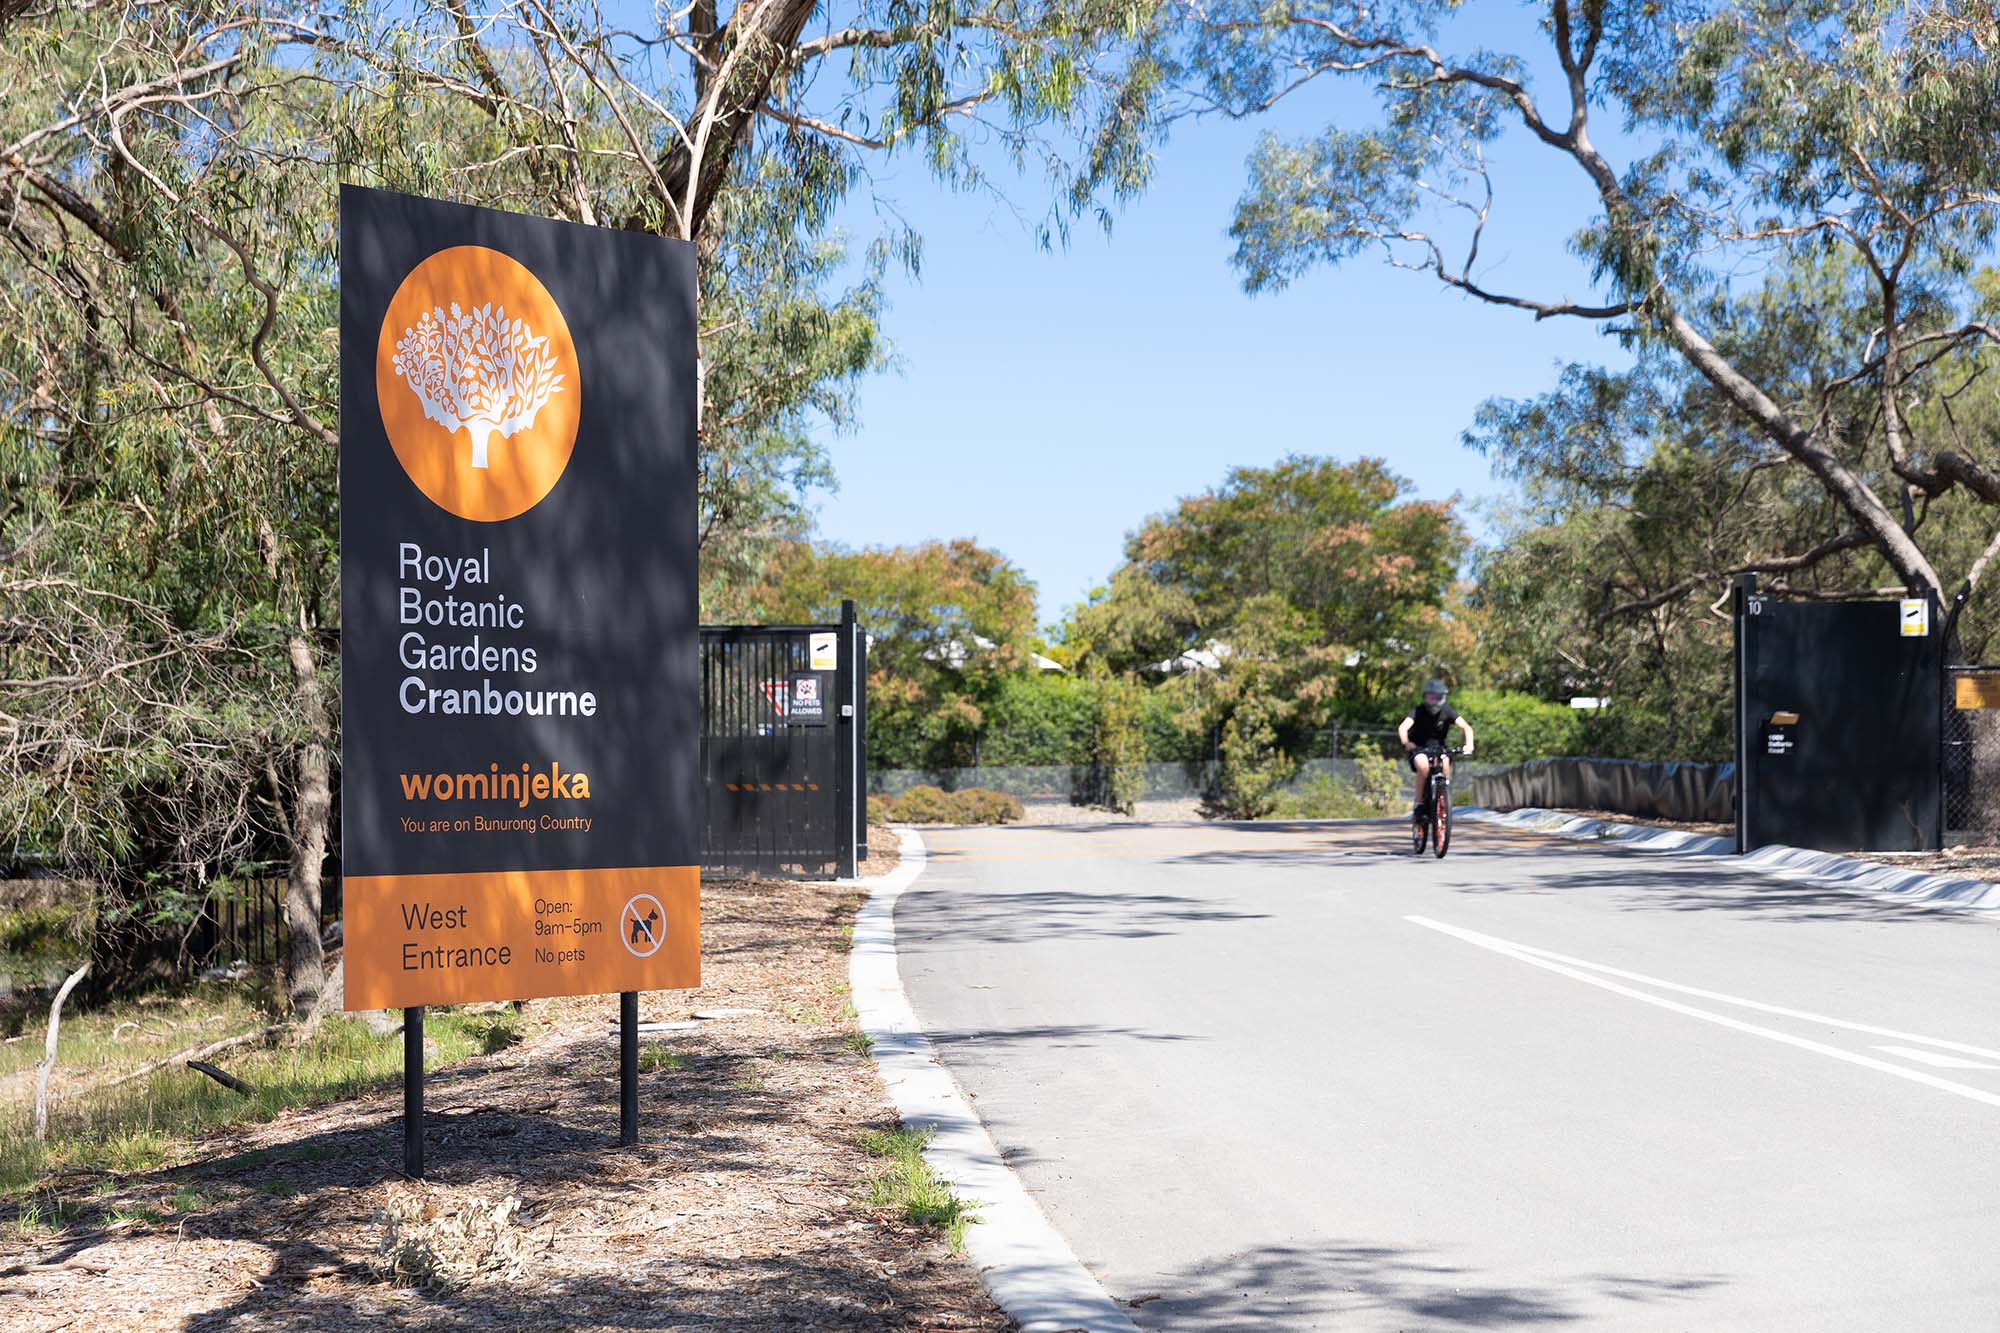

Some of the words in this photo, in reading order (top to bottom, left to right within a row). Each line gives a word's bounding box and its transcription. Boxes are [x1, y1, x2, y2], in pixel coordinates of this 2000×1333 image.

[399, 543, 489, 590] Royal
[399, 587, 524, 629] Botanic
[1748, 601, 1762, 615] 10
[399, 632, 537, 673] Gardens
[399, 676, 597, 717] Cranbourne
[400, 761, 590, 808] wominjeka
[401, 817, 425, 833] You
[429, 819, 450, 832] are
[454, 819, 471, 832] on
[474, 815, 536, 833] Bunurong
[540, 814, 592, 832] Country
[401, 903, 467, 931] West
[534, 898, 573, 917] Open:
[402, 943, 512, 971] Entrance
[535, 948, 554, 964] No
[557, 948, 586, 966] pets
